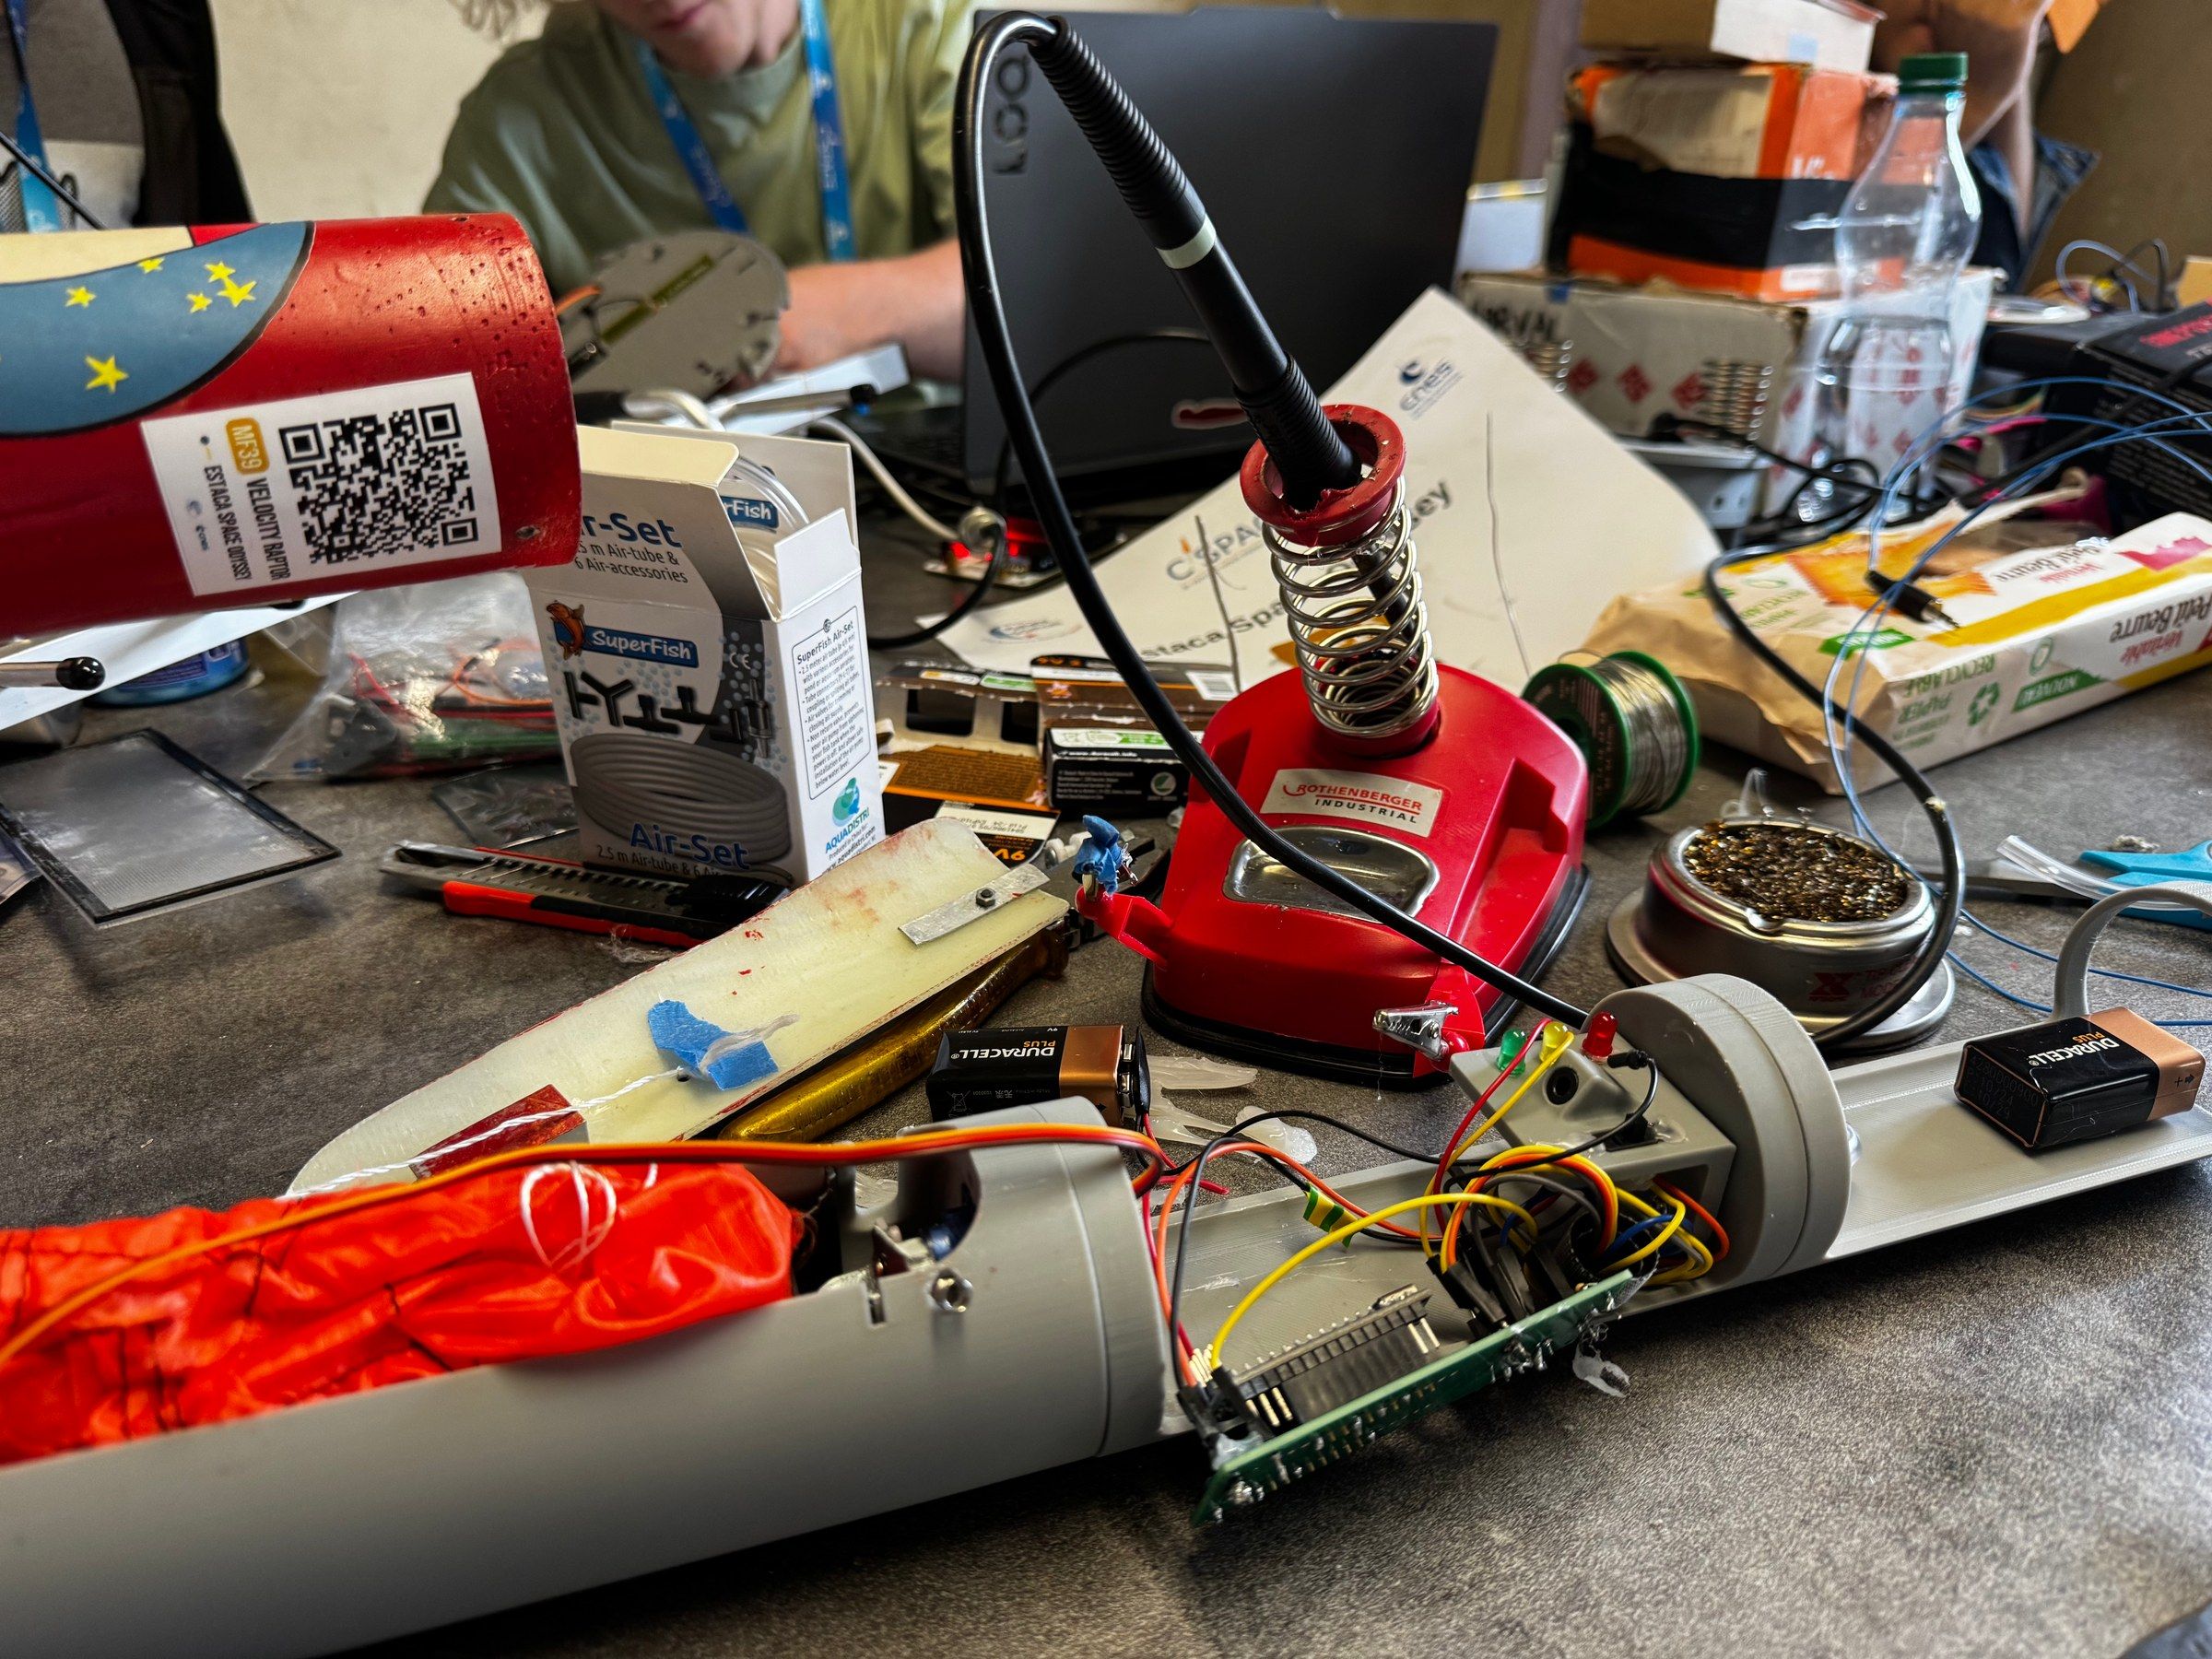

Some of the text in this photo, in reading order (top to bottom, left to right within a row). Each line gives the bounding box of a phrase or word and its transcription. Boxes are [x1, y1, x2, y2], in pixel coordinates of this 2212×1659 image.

[230, 424, 263, 471] MF39
[204, 465, 253, 582] ESTACA SPACE ODYSSEY
[246, 477, 292, 582] VELOCITY RAPTOR
[581, 512, 683, 548] r-Set
[574, 556, 689, 583] 6 Air-accessories
[590, 544, 606, 556] m
[607, 543, 664, 565] Air-tube
[669, 551, 679, 566] &
[1140, 600, 1285, 659] staca Spa
[2109, 605, 2174, 643] Beurre
[592, 629, 691, 661] SuperFish
[796, 620, 853, 665] SuperFish Air-Set
[1904, 653, 1996, 699] RECYCLABLE
[1283, 784, 1422, 811] ROTHENBERGER
[1314, 798, 1417, 824] INDUSTRIAL
[825, 806, 870, 854] AQUADISTRI
[597, 844, 614, 861] 2.5
[618, 852, 629, 864] m
[631, 852, 678, 874] Air-tube
[682, 865, 690, 875] &
[629, 823, 749, 870] Air-Set
[994, 848, 1026, 861] 9V
[1023, 1040, 1056, 1048] PLUS
[2029, 1036, 2121, 1065] DURACELL
[2072, 1030, 2106, 1044] PLUS
[959, 1048, 1055, 1059] DURACELL
